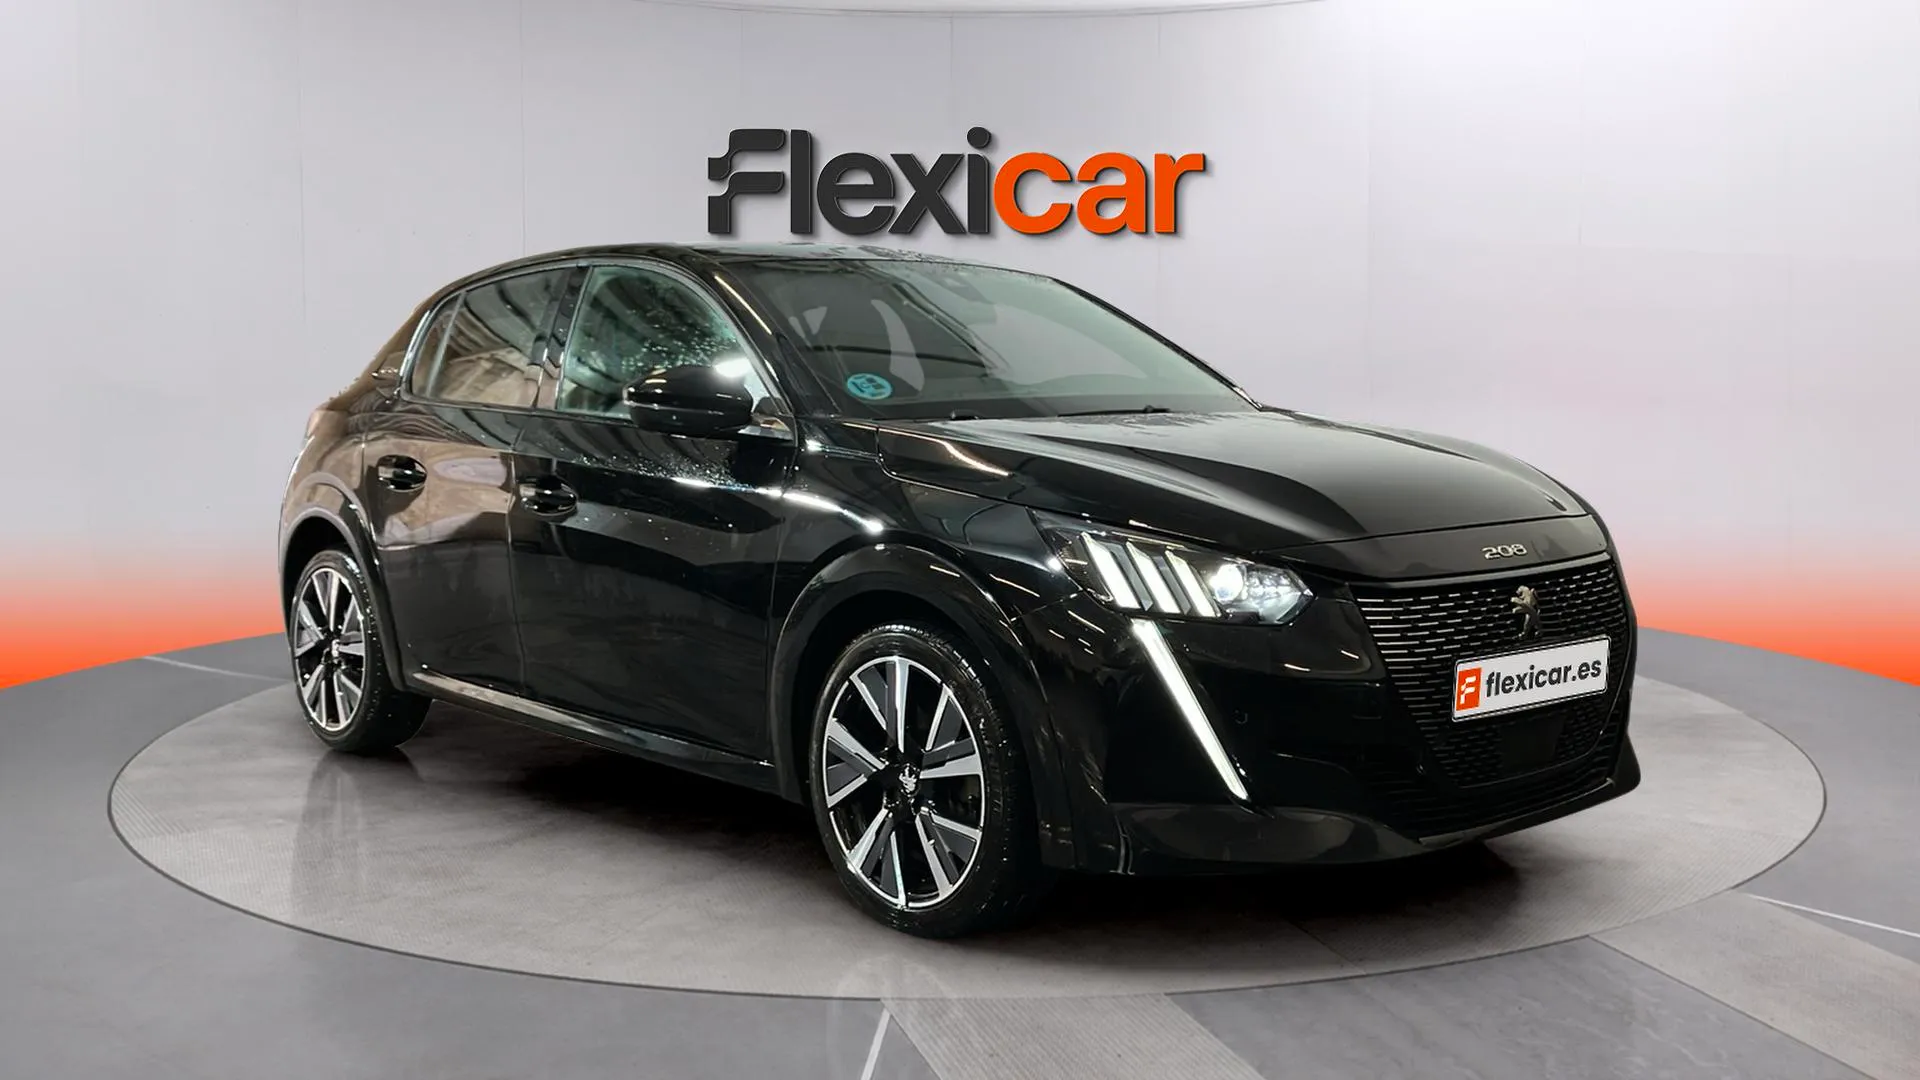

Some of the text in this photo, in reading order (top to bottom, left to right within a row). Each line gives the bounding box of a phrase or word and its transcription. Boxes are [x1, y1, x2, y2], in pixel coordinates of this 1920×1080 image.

[708, 127, 1206, 235] Flexicar
[1482, 543, 1528, 560] 208
[1486, 660, 1602, 698] flexicar.es
